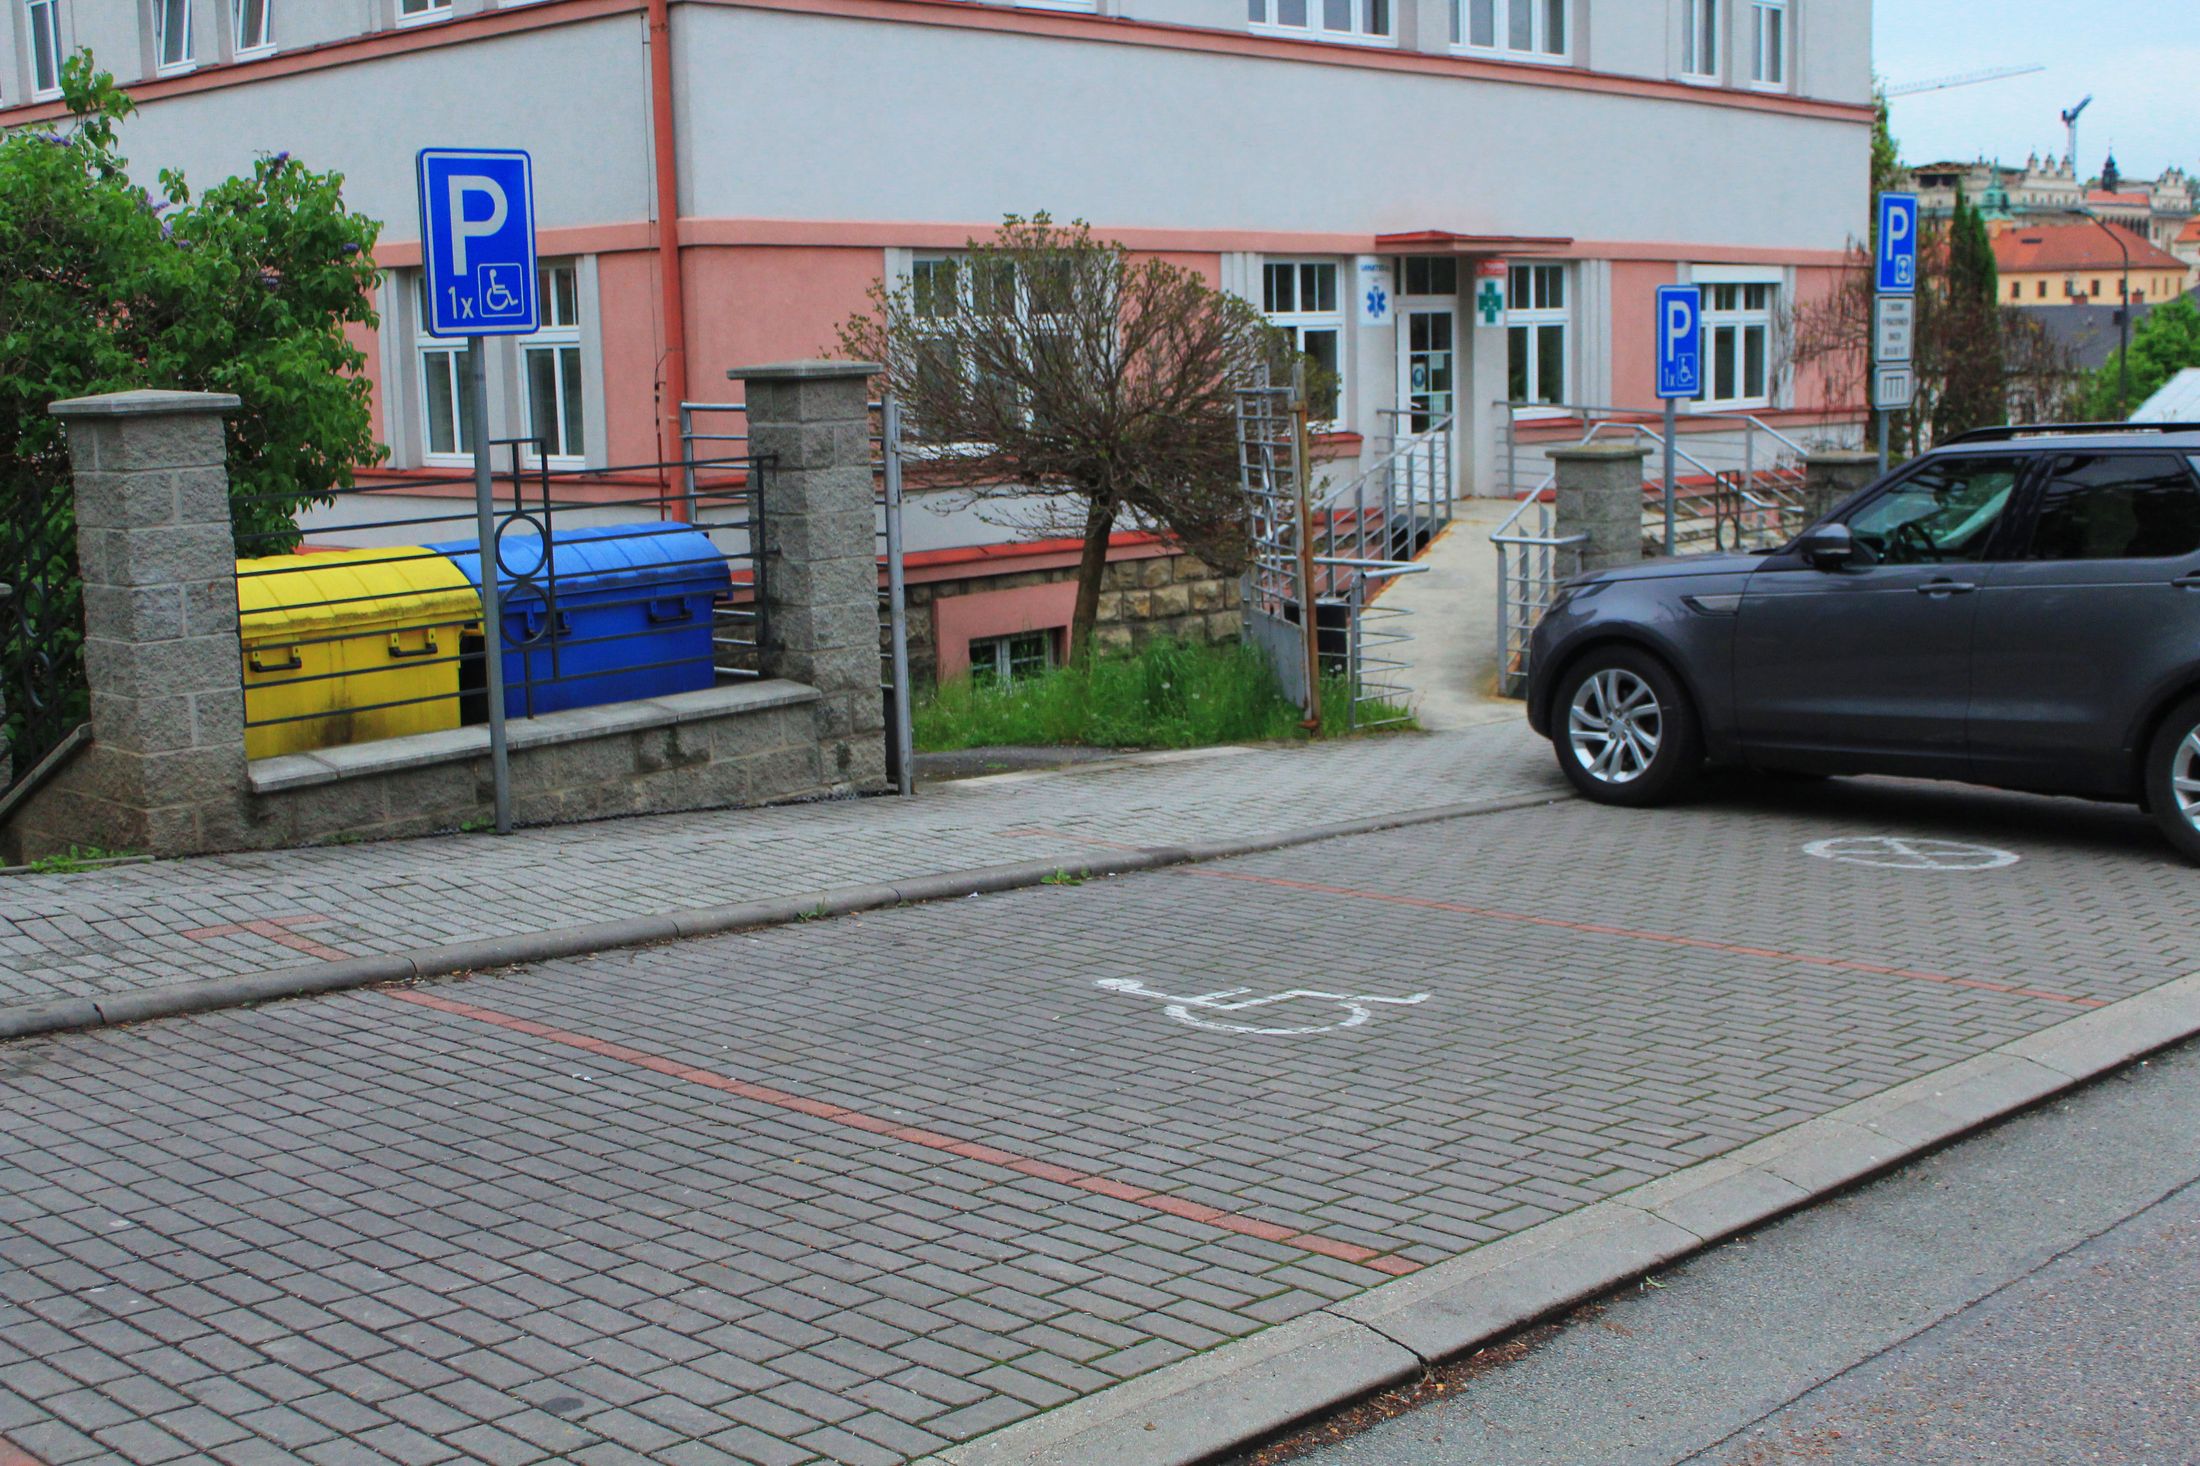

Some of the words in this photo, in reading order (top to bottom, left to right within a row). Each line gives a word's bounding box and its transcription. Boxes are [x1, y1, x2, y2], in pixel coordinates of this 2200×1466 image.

[448, 175, 508, 276] P
[1887, 206, 1909, 261] P
[448, 286, 474, 319] 1x
[1667, 300, 1692, 362] P
